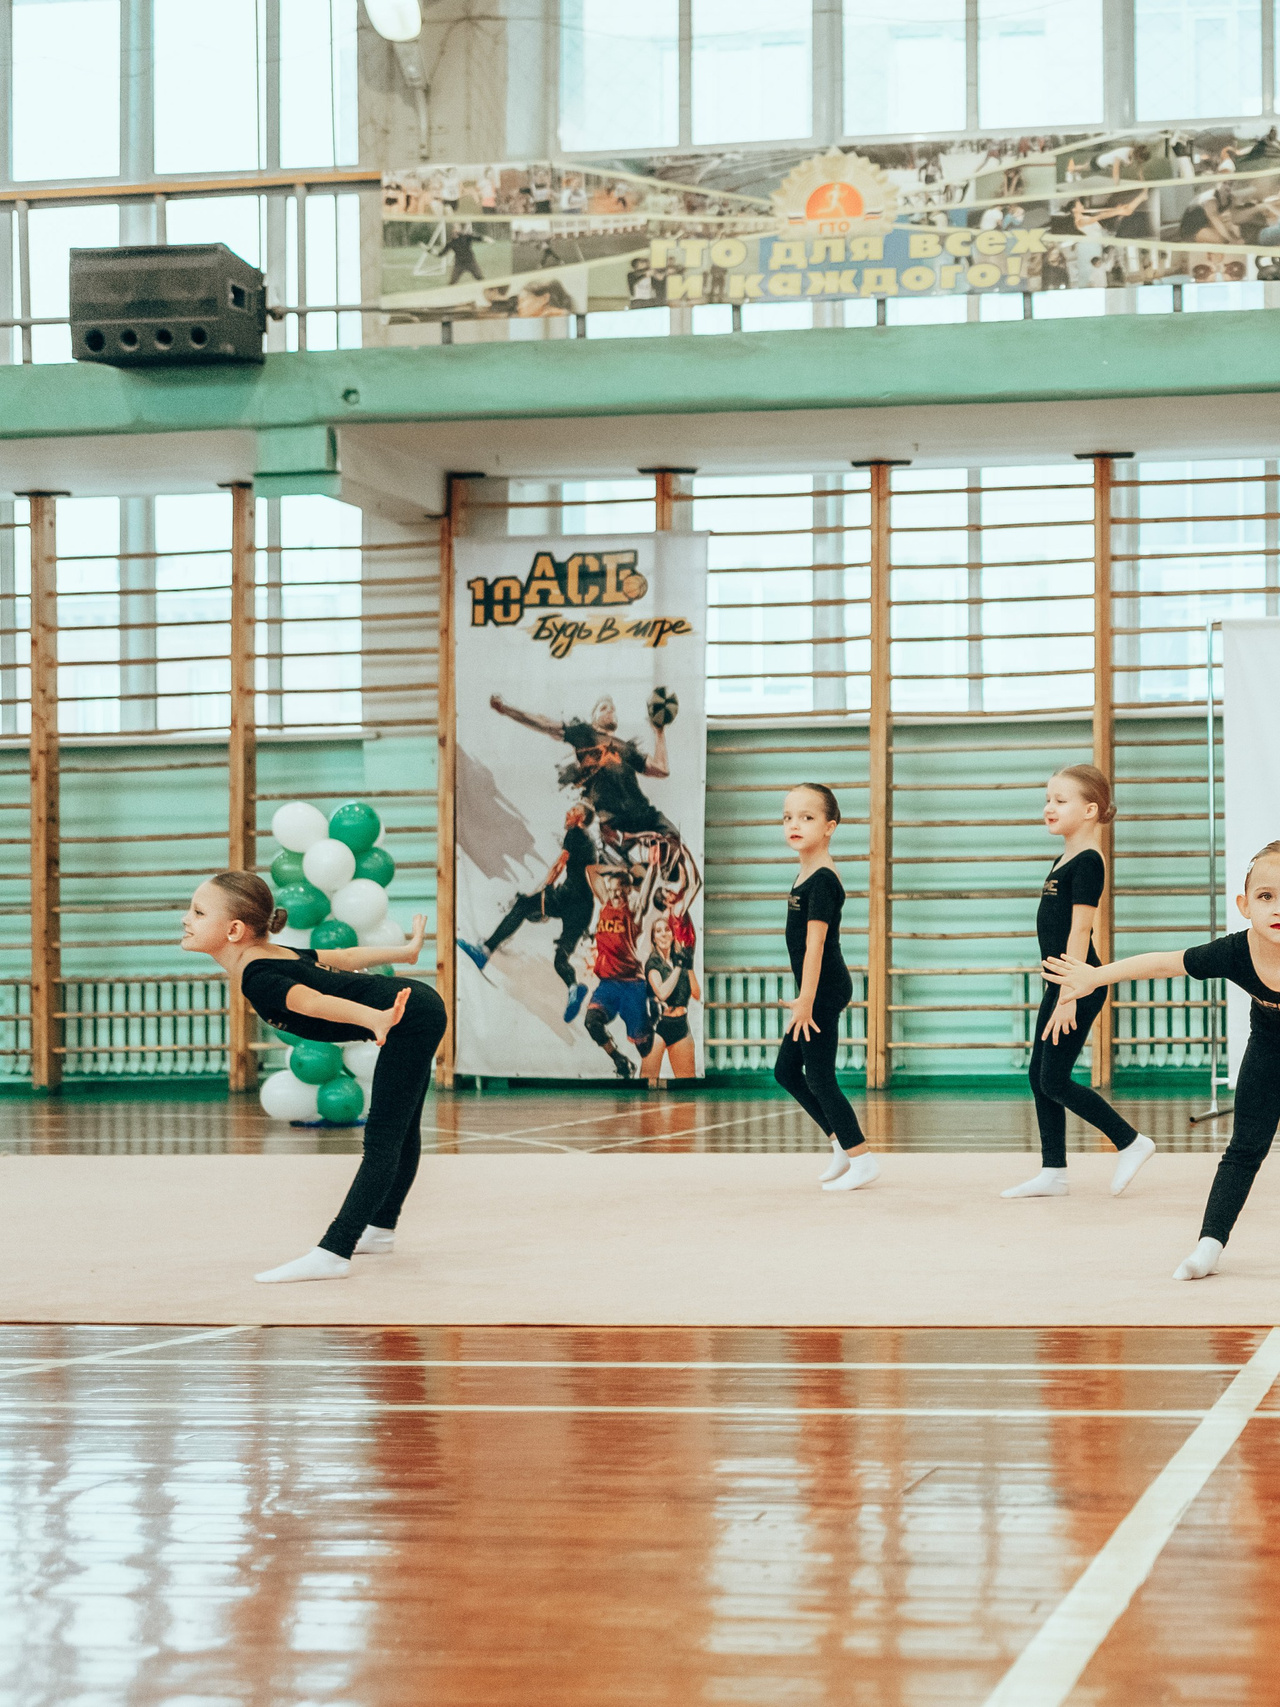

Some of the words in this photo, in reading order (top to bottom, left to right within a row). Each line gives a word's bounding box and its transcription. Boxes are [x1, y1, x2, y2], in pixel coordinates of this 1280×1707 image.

[818, 221, 850, 234] ГТО
[650, 238, 747, 269] ГТО
[768, 236, 884, 270] для
[909, 229, 1049, 259] всех
[666, 274, 704, 300] и
[729, 256, 1022, 298] каждого!
